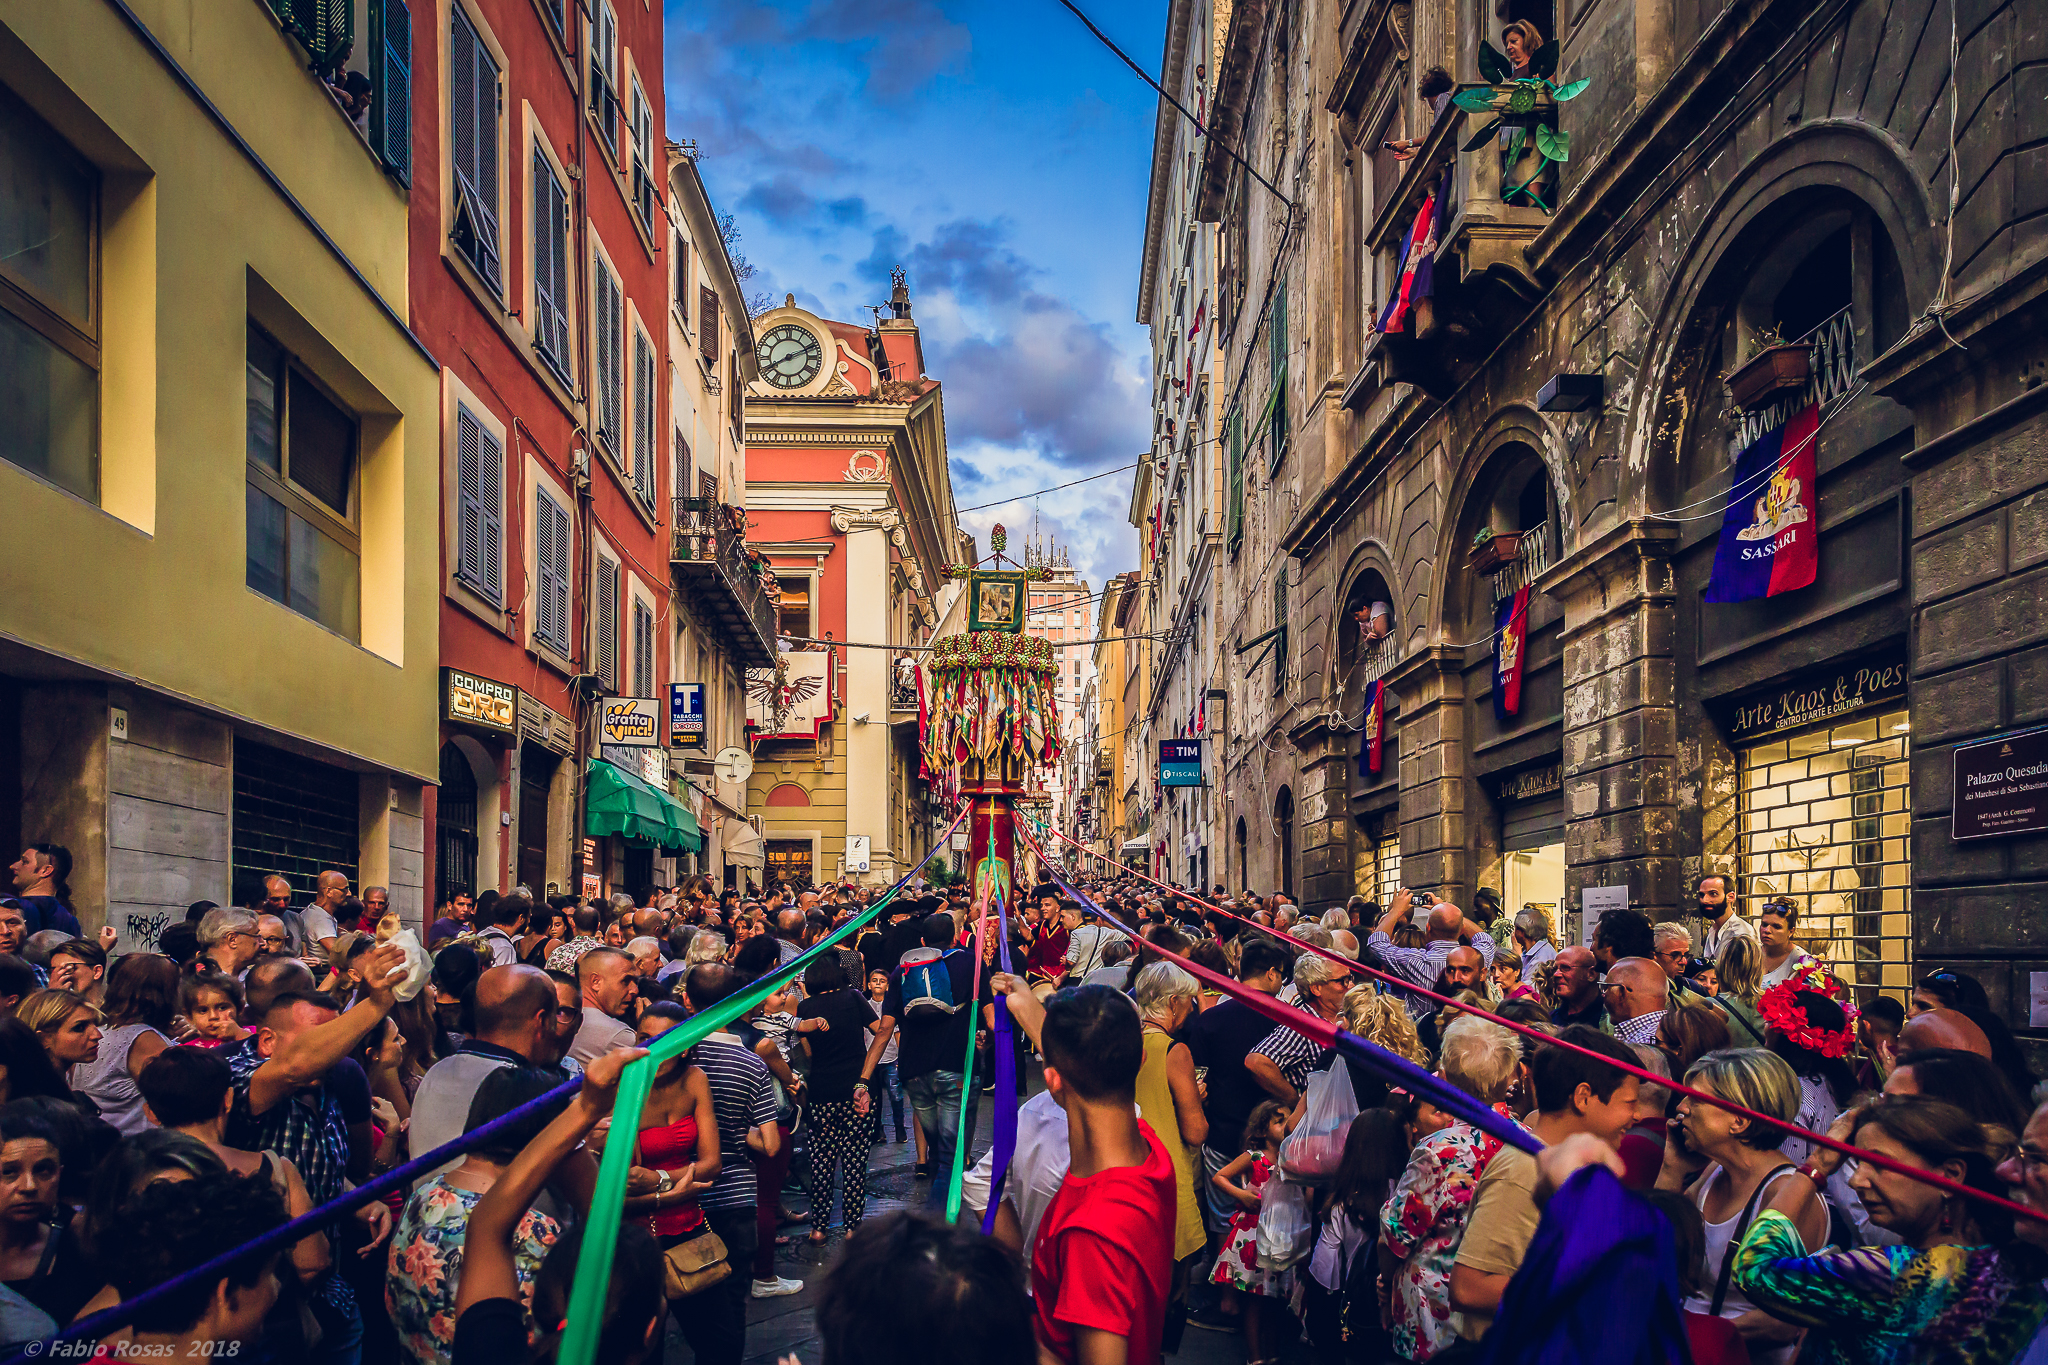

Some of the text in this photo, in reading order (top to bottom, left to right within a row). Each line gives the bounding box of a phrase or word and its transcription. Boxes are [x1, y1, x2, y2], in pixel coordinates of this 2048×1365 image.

[1740, 529, 1797, 561] SASSARI
[454, 674, 513, 701] COMPRO
[675, 685, 699, 713] T
[1732, 663, 1909, 732] Arte Kaos & Poes
[454, 686, 513, 725] ORO
[1775, 696, 1864, 729] CENTRO D'ARTE E CULTURA
[114, 716, 125, 731] 49
[607, 713, 648, 726] Gratta
[1176, 746, 1198, 757] TIM
[1966, 761, 2048, 787] Palazzo Quesada
[1965, 792, 1974, 800] dei
[1974, 788, 1999, 799] Marchesi
[2000, 787, 2006, 795] di
[2007, 785, 2018, 794] San
